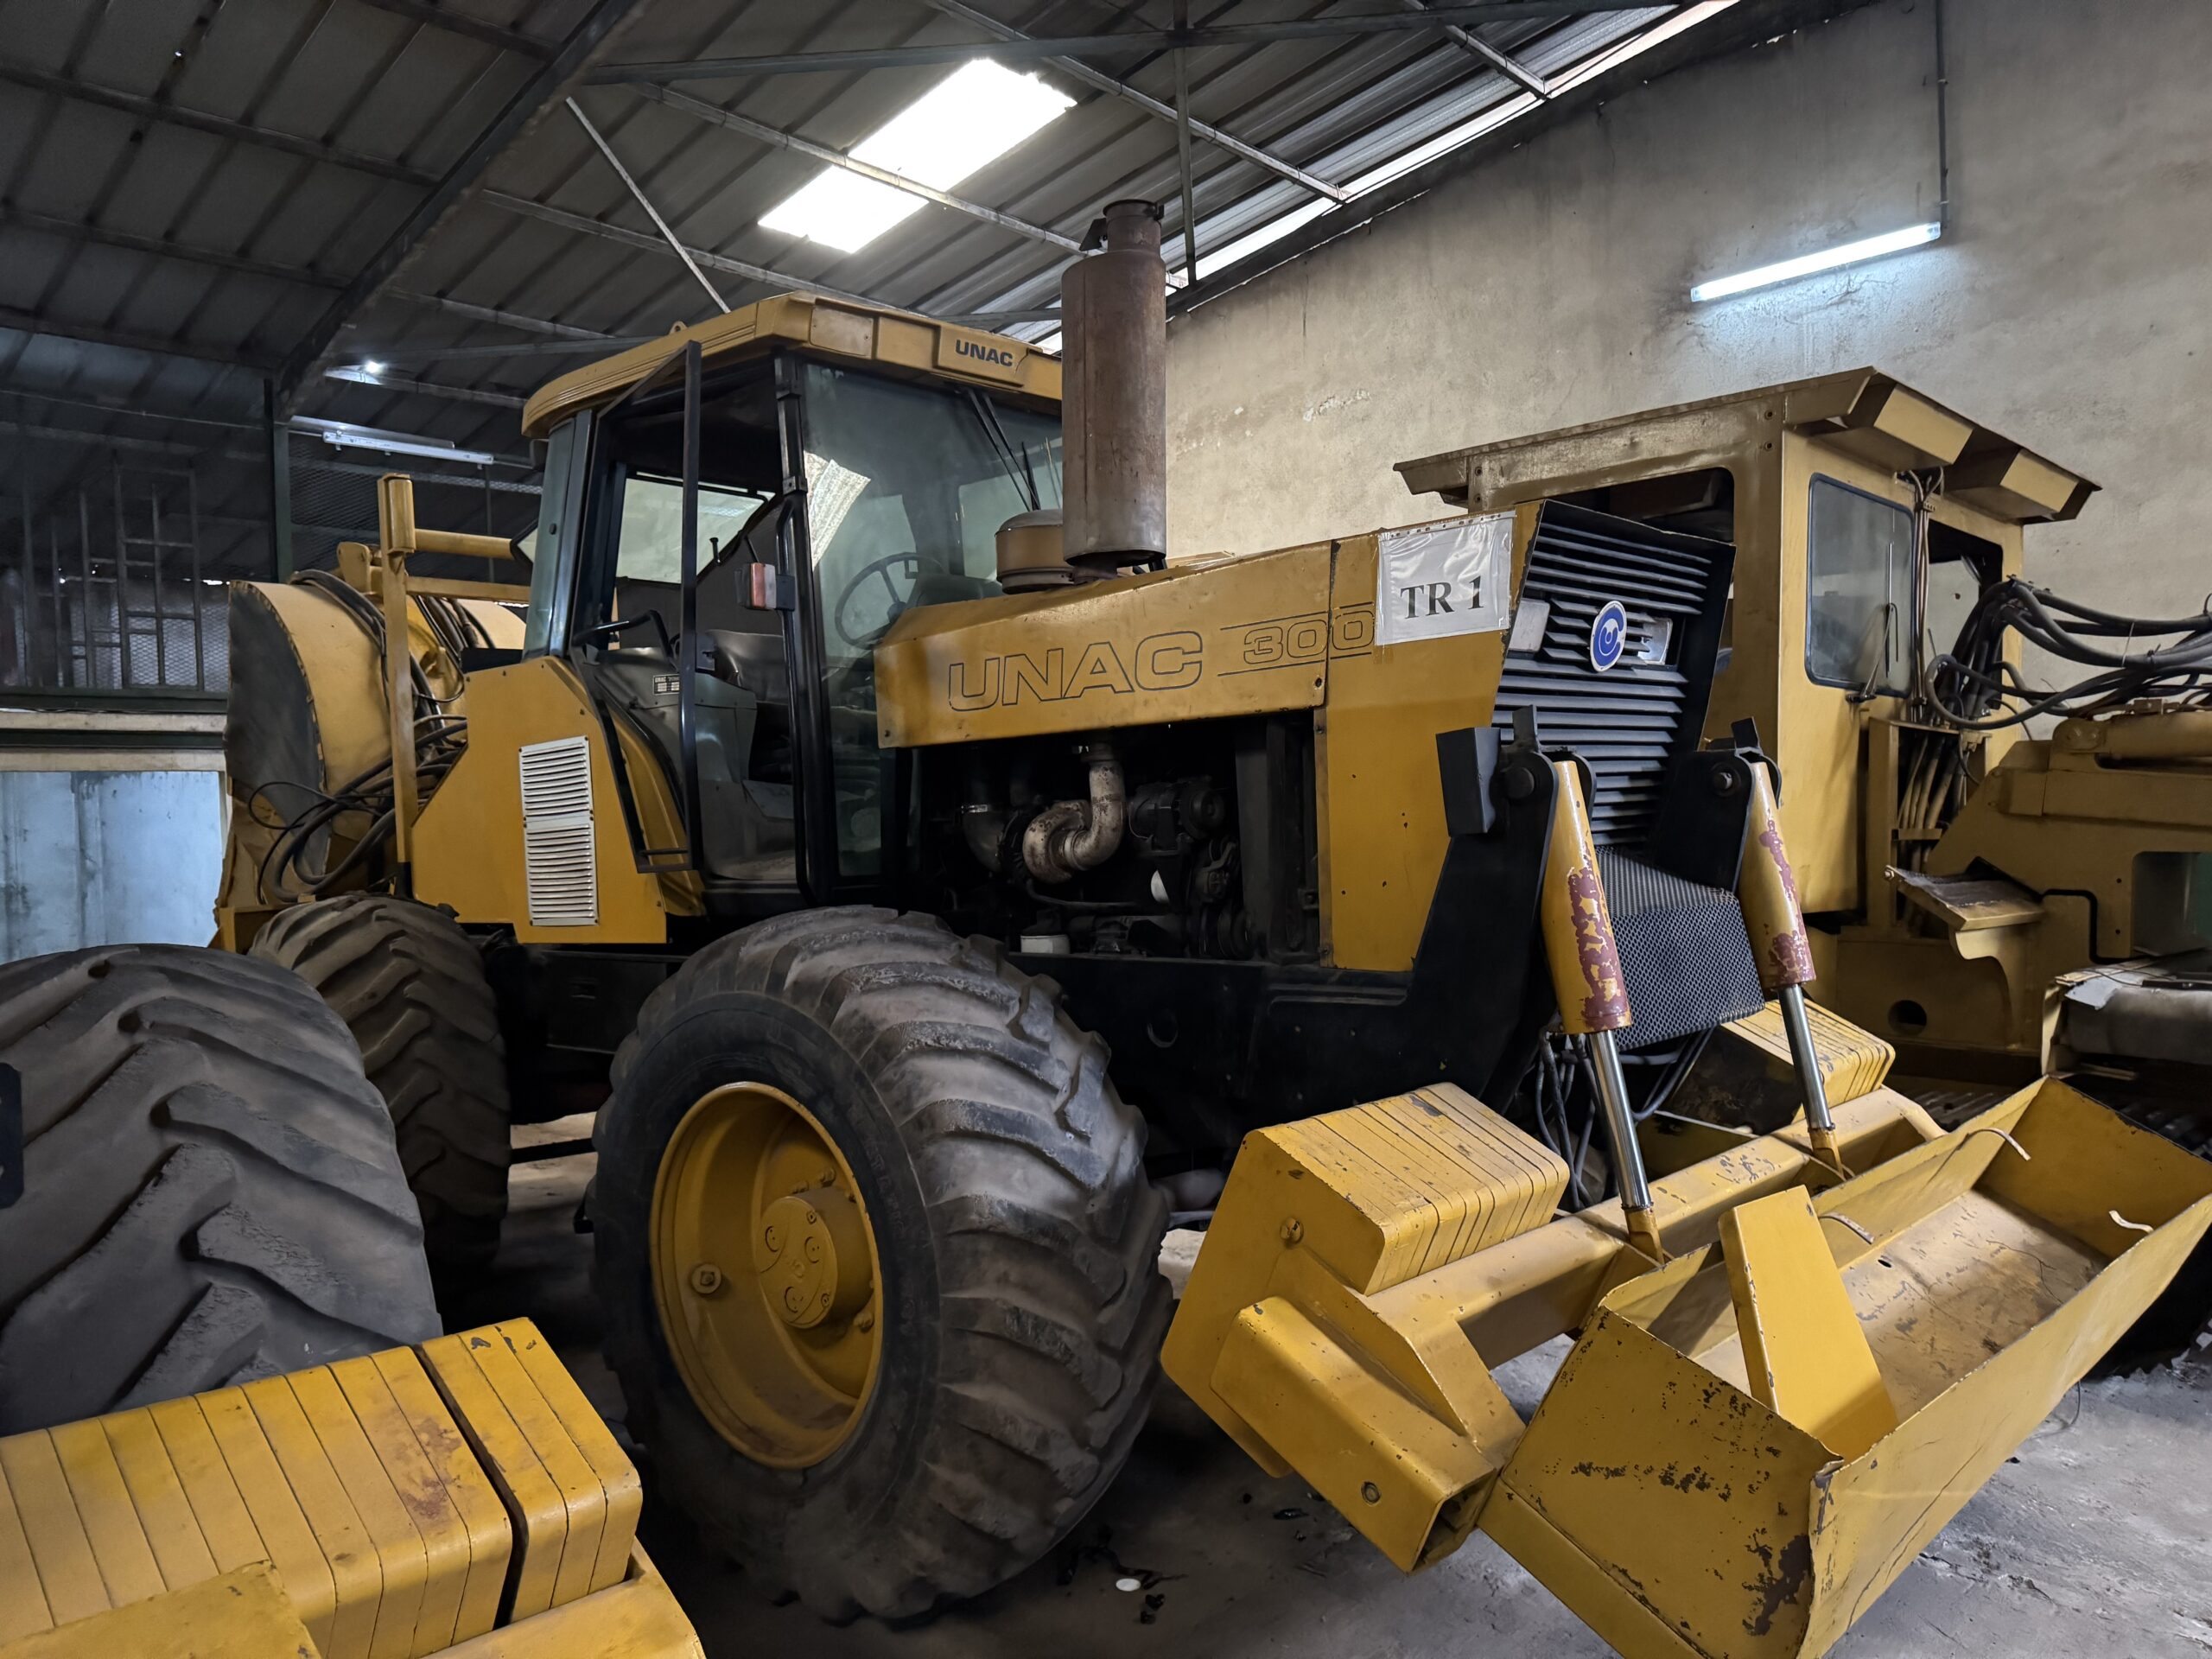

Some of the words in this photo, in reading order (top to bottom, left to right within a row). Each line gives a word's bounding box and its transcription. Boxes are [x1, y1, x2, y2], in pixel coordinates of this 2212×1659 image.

[956, 339, 1014, 367] UNAC
[1400, 582, 1455, 620] TR
[1467, 575, 1484, 610] 1
[948, 630, 1204, 712] UNAC
[1243, 610, 1376, 665] 300
